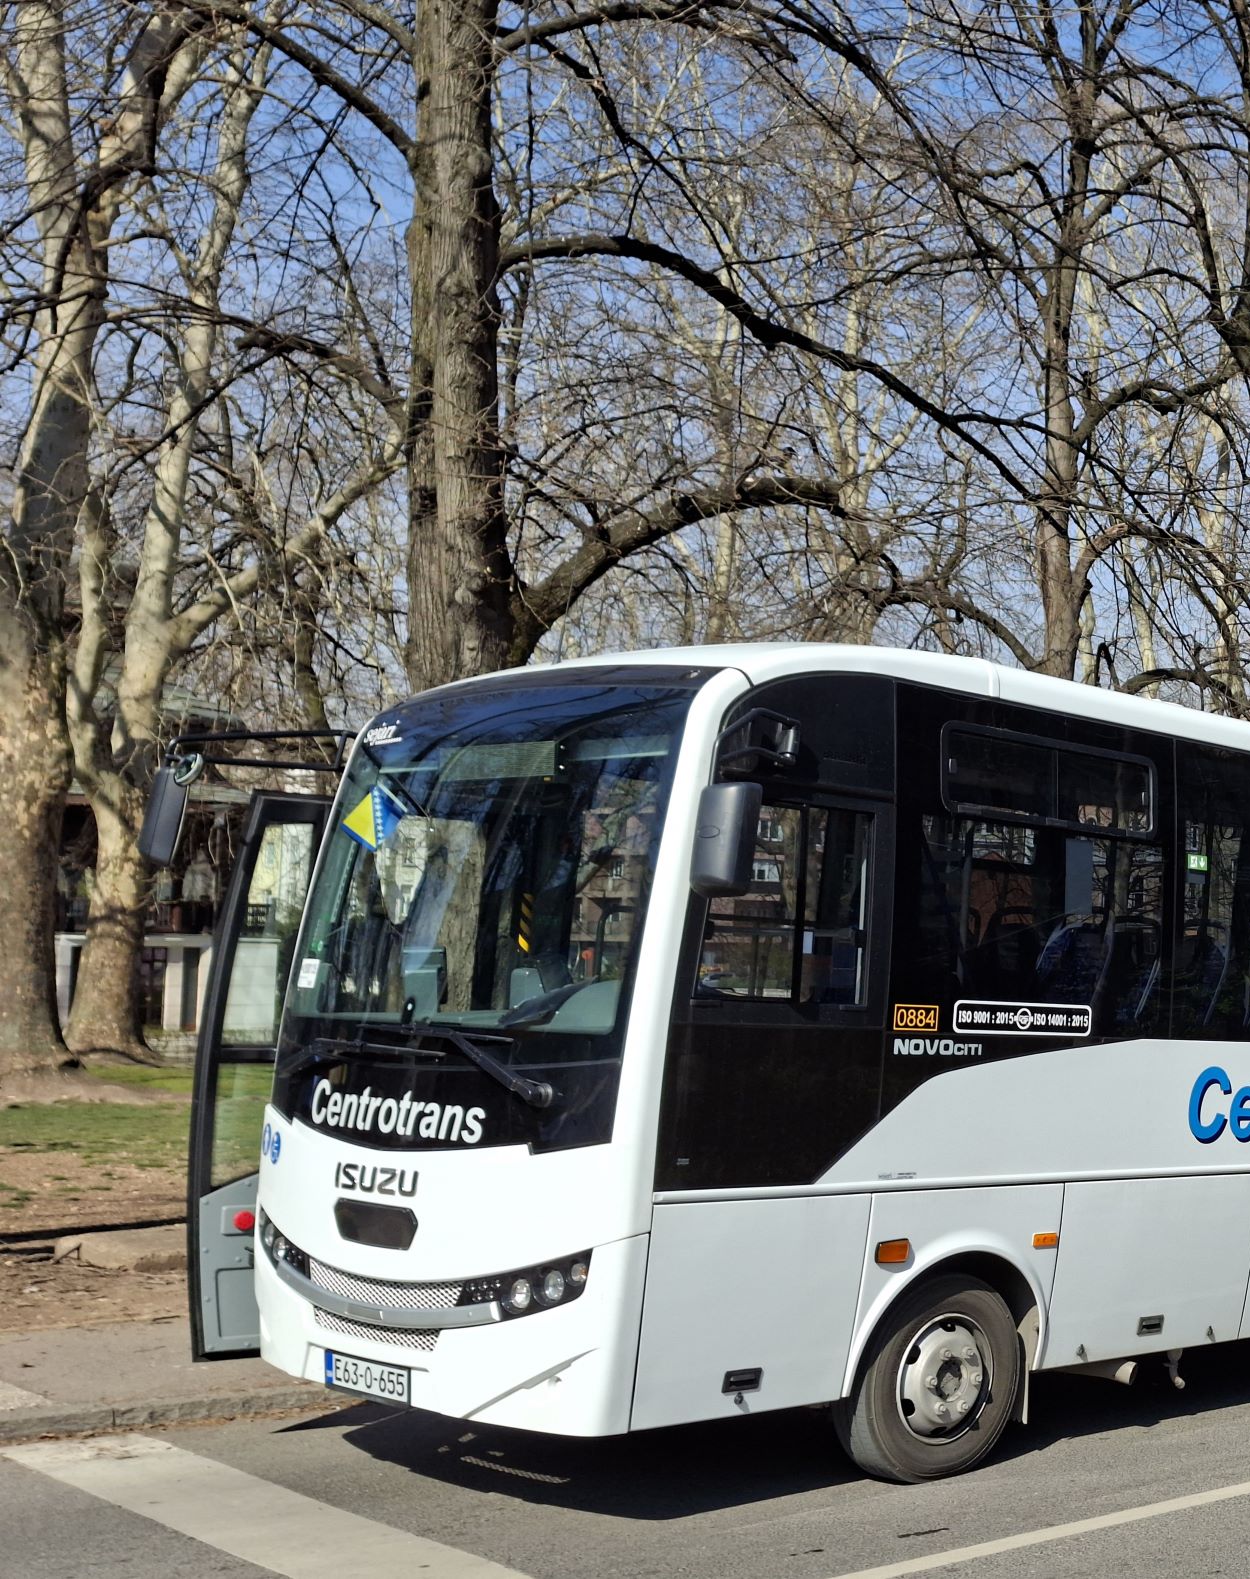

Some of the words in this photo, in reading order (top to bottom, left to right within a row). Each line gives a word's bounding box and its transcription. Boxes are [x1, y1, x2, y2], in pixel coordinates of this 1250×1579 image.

[897, 1008, 936, 1027] 0884
[958, 1010, 972, 1023] ISO
[973, 1011, 990, 1024] 9001
[996, 1012, 1014, 1024] 2015
[1033, 1013, 1046, 1026] ISO
[1048, 1014, 1066, 1026] 14001
[1072, 1015, 1089, 1027] 2015
[311, 1078, 486, 1144] Centrotrans
[334, 1162, 419, 1197] ISUZU
[334, 1358, 405, 1397] E63-0-655
